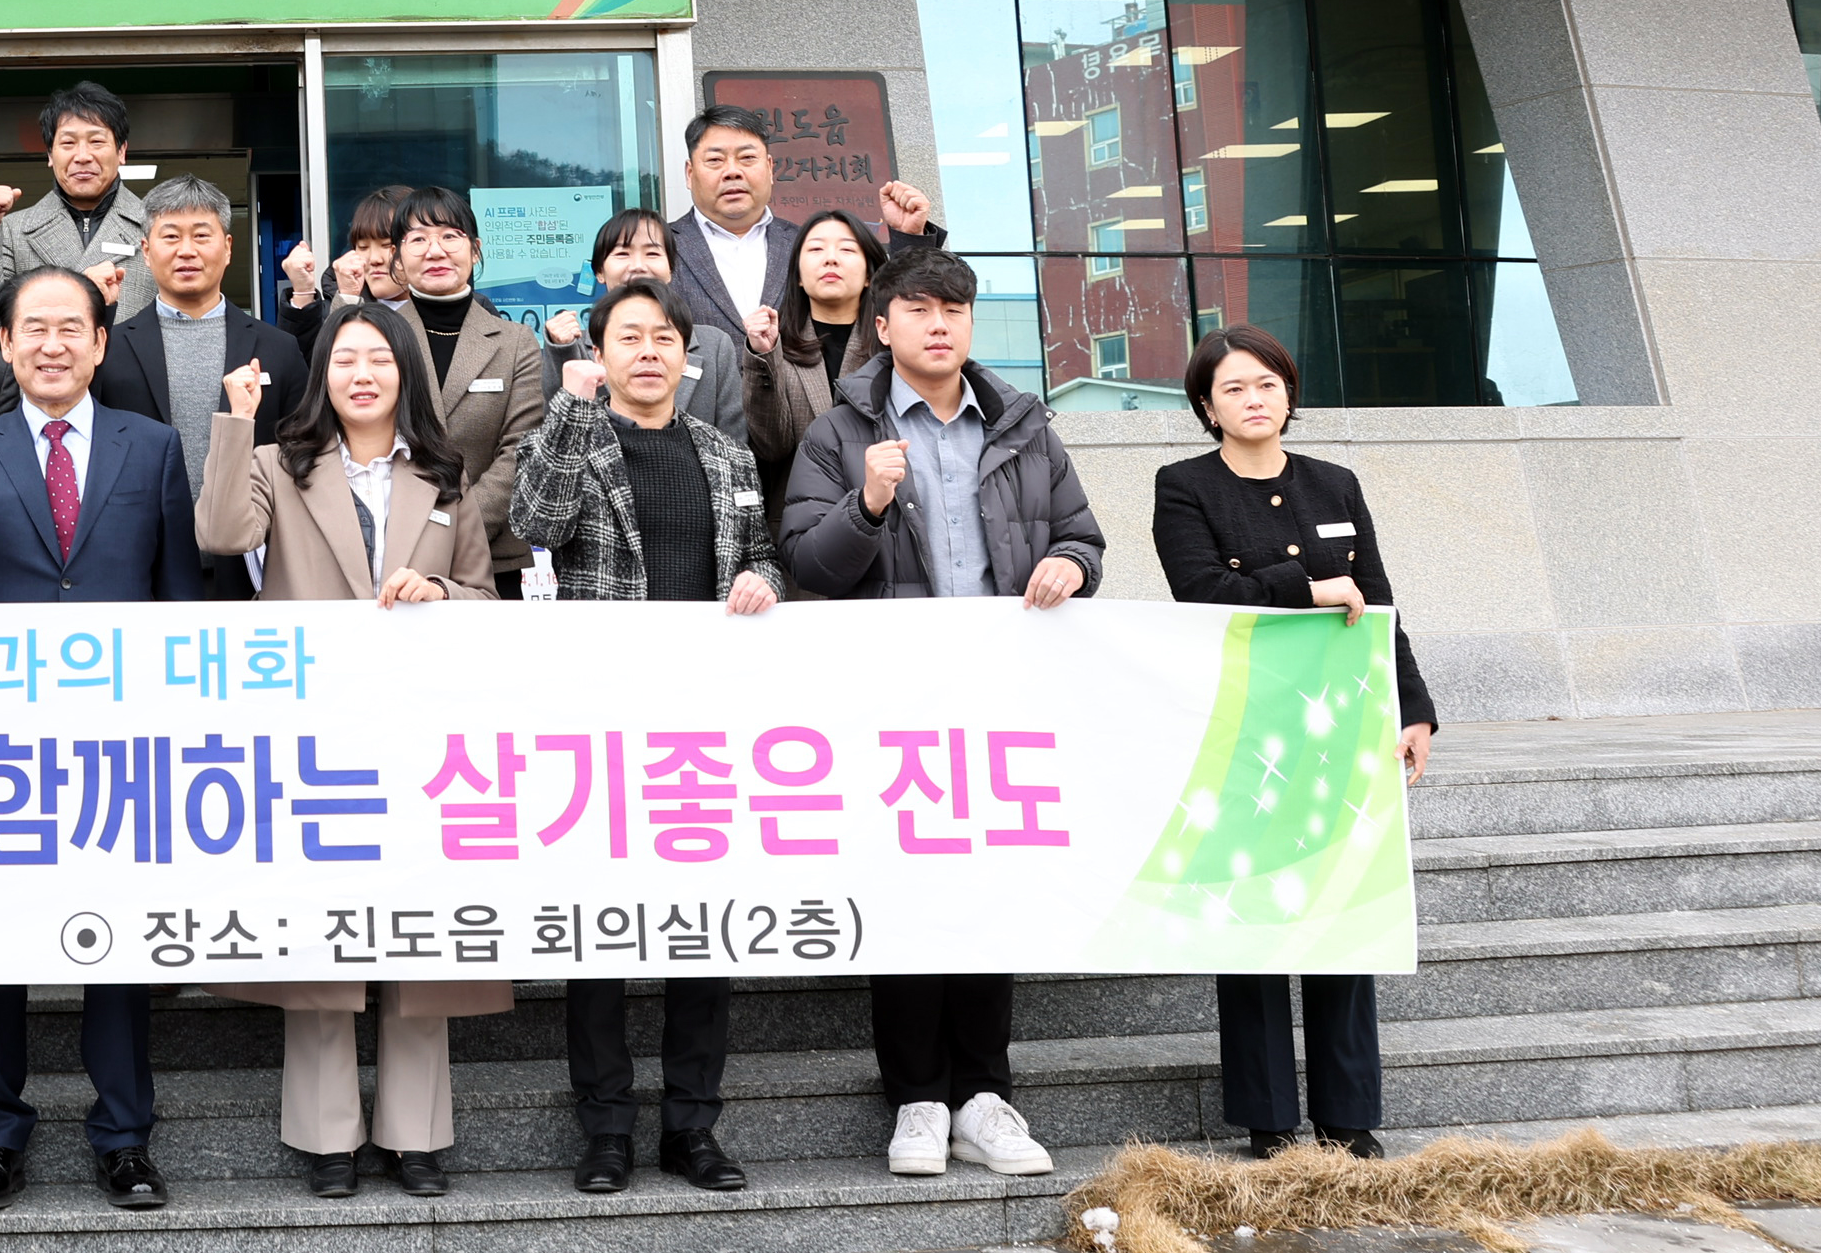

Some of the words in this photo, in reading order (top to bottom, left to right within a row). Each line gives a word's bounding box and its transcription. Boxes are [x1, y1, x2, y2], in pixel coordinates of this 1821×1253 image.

[485, 208, 494, 218] AI
[498, 207, 525, 217] 프로필
[529, 207, 557, 217] 사진은
[485, 221, 533, 232] 인위적으로
[486, 235, 524, 245] 사진으로
[526, 233, 584, 245] 주민등록증에
[486, 249, 514, 260] 사용할
[518, 249, 527, 258] 수
[530, 248, 570, 259] 없습니다.
[166, 627, 314, 699] 대화
[423, 727, 843, 862] 살기좋은
[880, 729, 1069, 854] 진도
[144, 909, 288, 966] 장소:
[325, 906, 504, 962] 진도읍
[532, 898, 862, 962] 회의실(2층)
